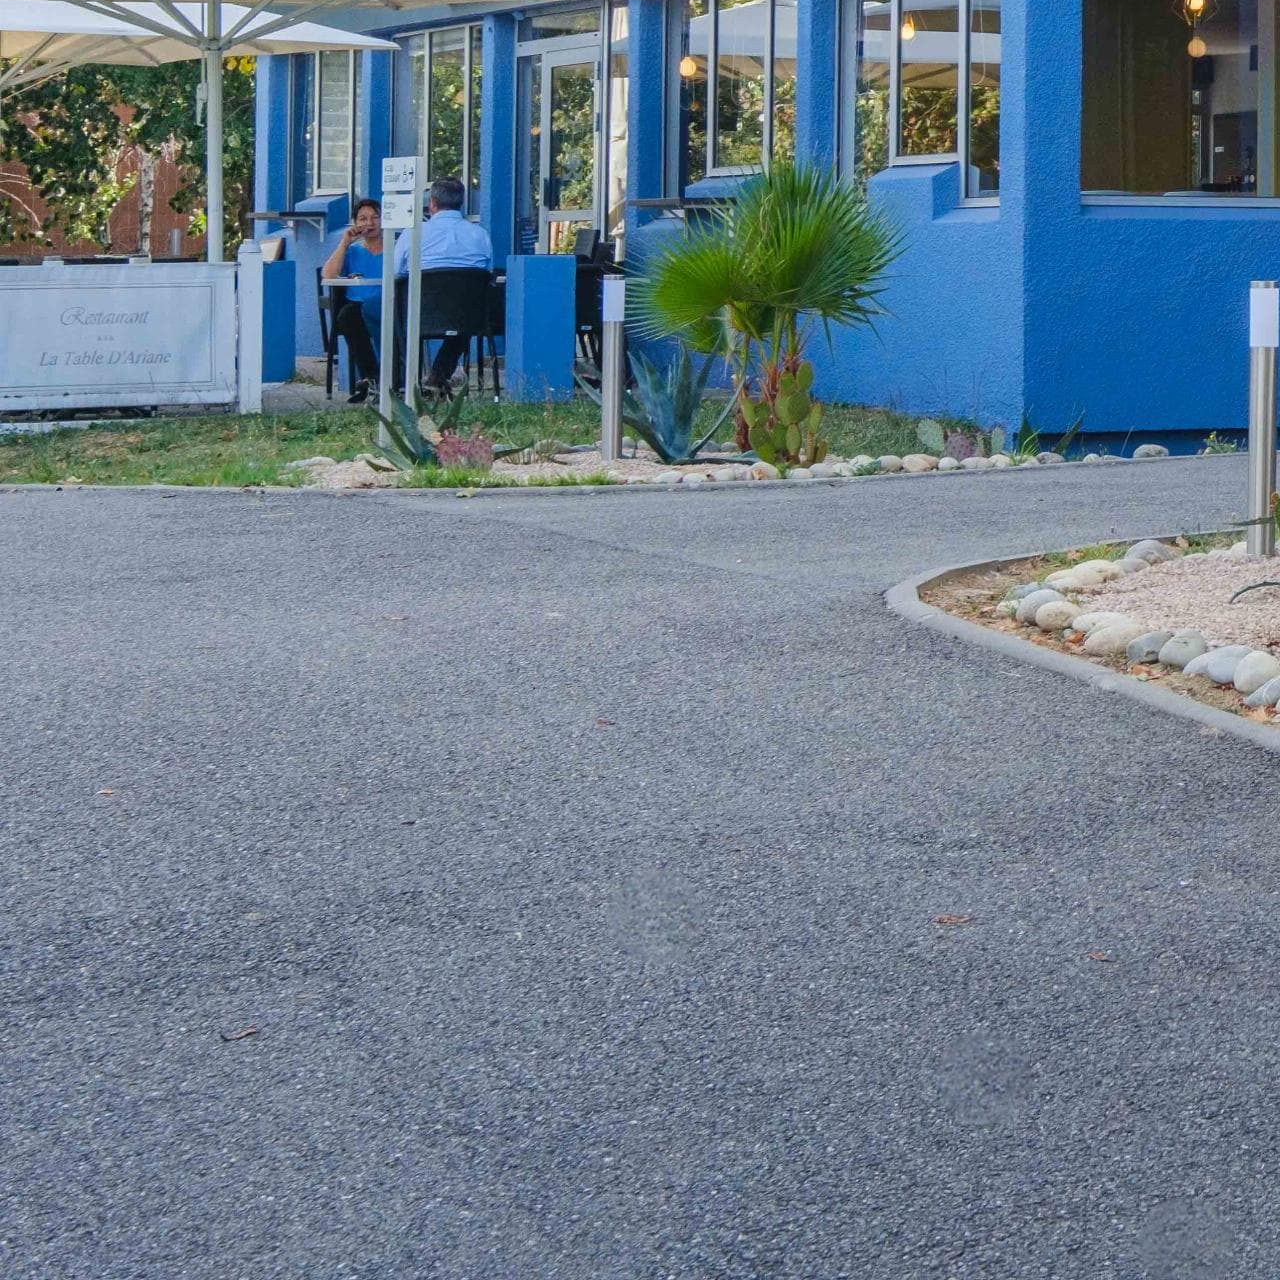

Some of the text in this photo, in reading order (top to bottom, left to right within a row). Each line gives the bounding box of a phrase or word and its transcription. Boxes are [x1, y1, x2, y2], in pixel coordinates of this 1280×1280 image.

[60, 306, 149, 326] Restaurant
[40, 349, 172, 367] La Table D'Ariane
